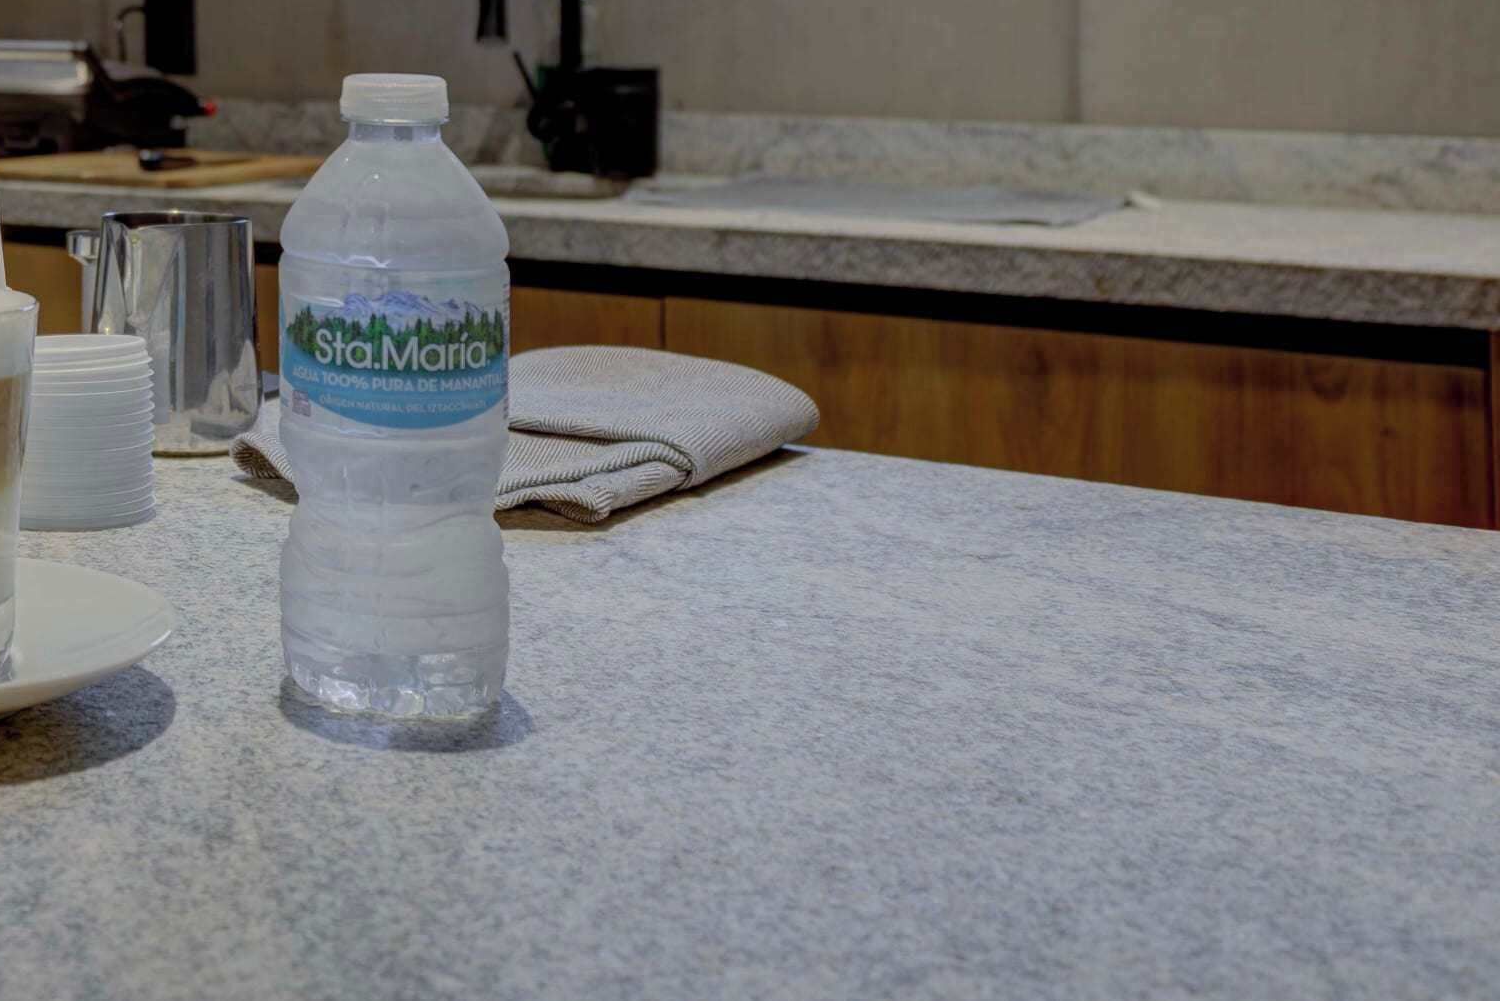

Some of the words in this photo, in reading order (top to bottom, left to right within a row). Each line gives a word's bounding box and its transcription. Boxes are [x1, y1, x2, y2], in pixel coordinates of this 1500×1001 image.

[315, 328, 487, 372] Sta.María
[293, 366, 319, 384] AGUA
[323, 370, 370, 390] 100%
[372, 374, 412, 392] PURA
[417, 375, 438, 392] DE
